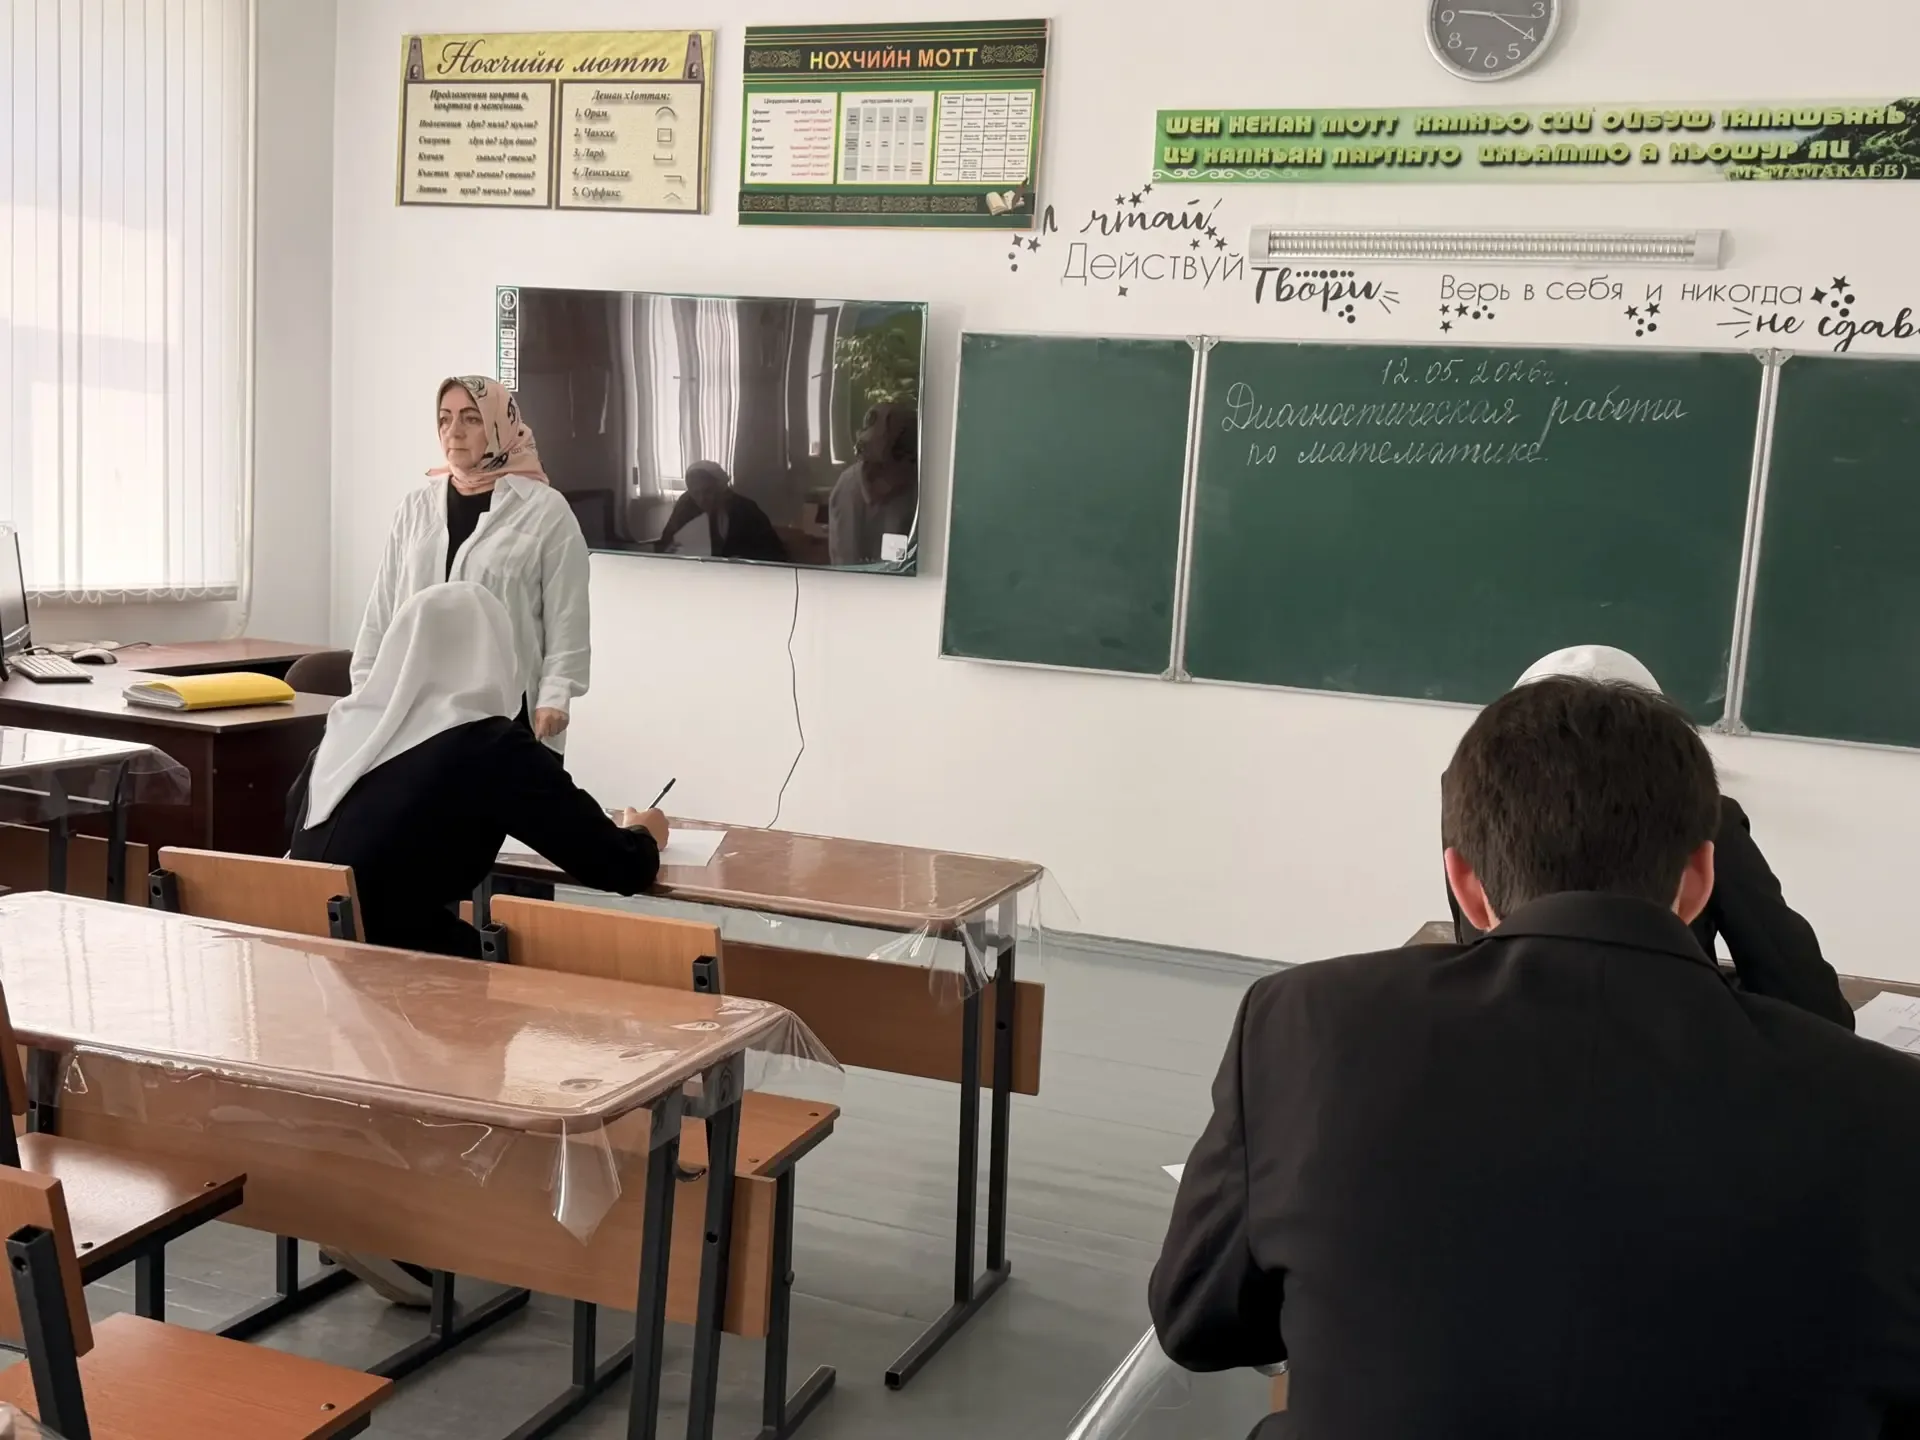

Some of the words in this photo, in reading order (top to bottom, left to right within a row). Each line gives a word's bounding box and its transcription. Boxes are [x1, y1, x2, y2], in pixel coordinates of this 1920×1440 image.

[1441, 10, 1455, 26] 9
[1531, 2, 1545, 18] 3
[1447, 32, 1462, 49] 8
[1523, 27, 1536, 42] 4
[437, 39, 565, 74] Нохчийн
[573, 55, 670, 73] мотт
[810, 45, 911, 69] НОХЧИЙН
[918, 47, 979, 68] МОТТ
[1464, 47, 1478, 63] 7
[1484, 51, 1498, 68] 6
[1506, 43, 1521, 60] 5
[592, 90, 622, 101] Дешан
[575, 108, 581, 117] 1.
[584, 108, 608, 119] Орам
[574, 128, 581, 137] 2.
[1166, 115, 1222, 136] ШЕН
[1229, 115, 1314, 136] НЕНАН
[1321, 114, 1399, 135] МОТТ
[573, 148, 580, 157] 3.
[1164, 146, 1197, 166] ЦУ
[1640, 142, 1660, 163] А
[1808, 140, 1851, 160] ЯЦ
[572, 167, 579, 177] 4.
[572, 187, 579, 197] 5.
[582, 187, 621, 198] Суффикс
[1061, 243, 1244, 290] Действуй
[1250, 266, 1382, 312] Твори
[1440, 274, 1510, 306] Верь
[1524, 284, 1535, 301] в
[1546, 274, 1623, 301] себя
[1646, 284, 1662, 302] и
[1681, 283, 1803, 305] никогда
[1756, 313, 1804, 335] не
[1817, 307, 1920, 353] сдав
[1222, 381, 1522, 431] Диагностическая
[1539, 384, 1689, 447] работа
[1247, 442, 1277, 466] по
